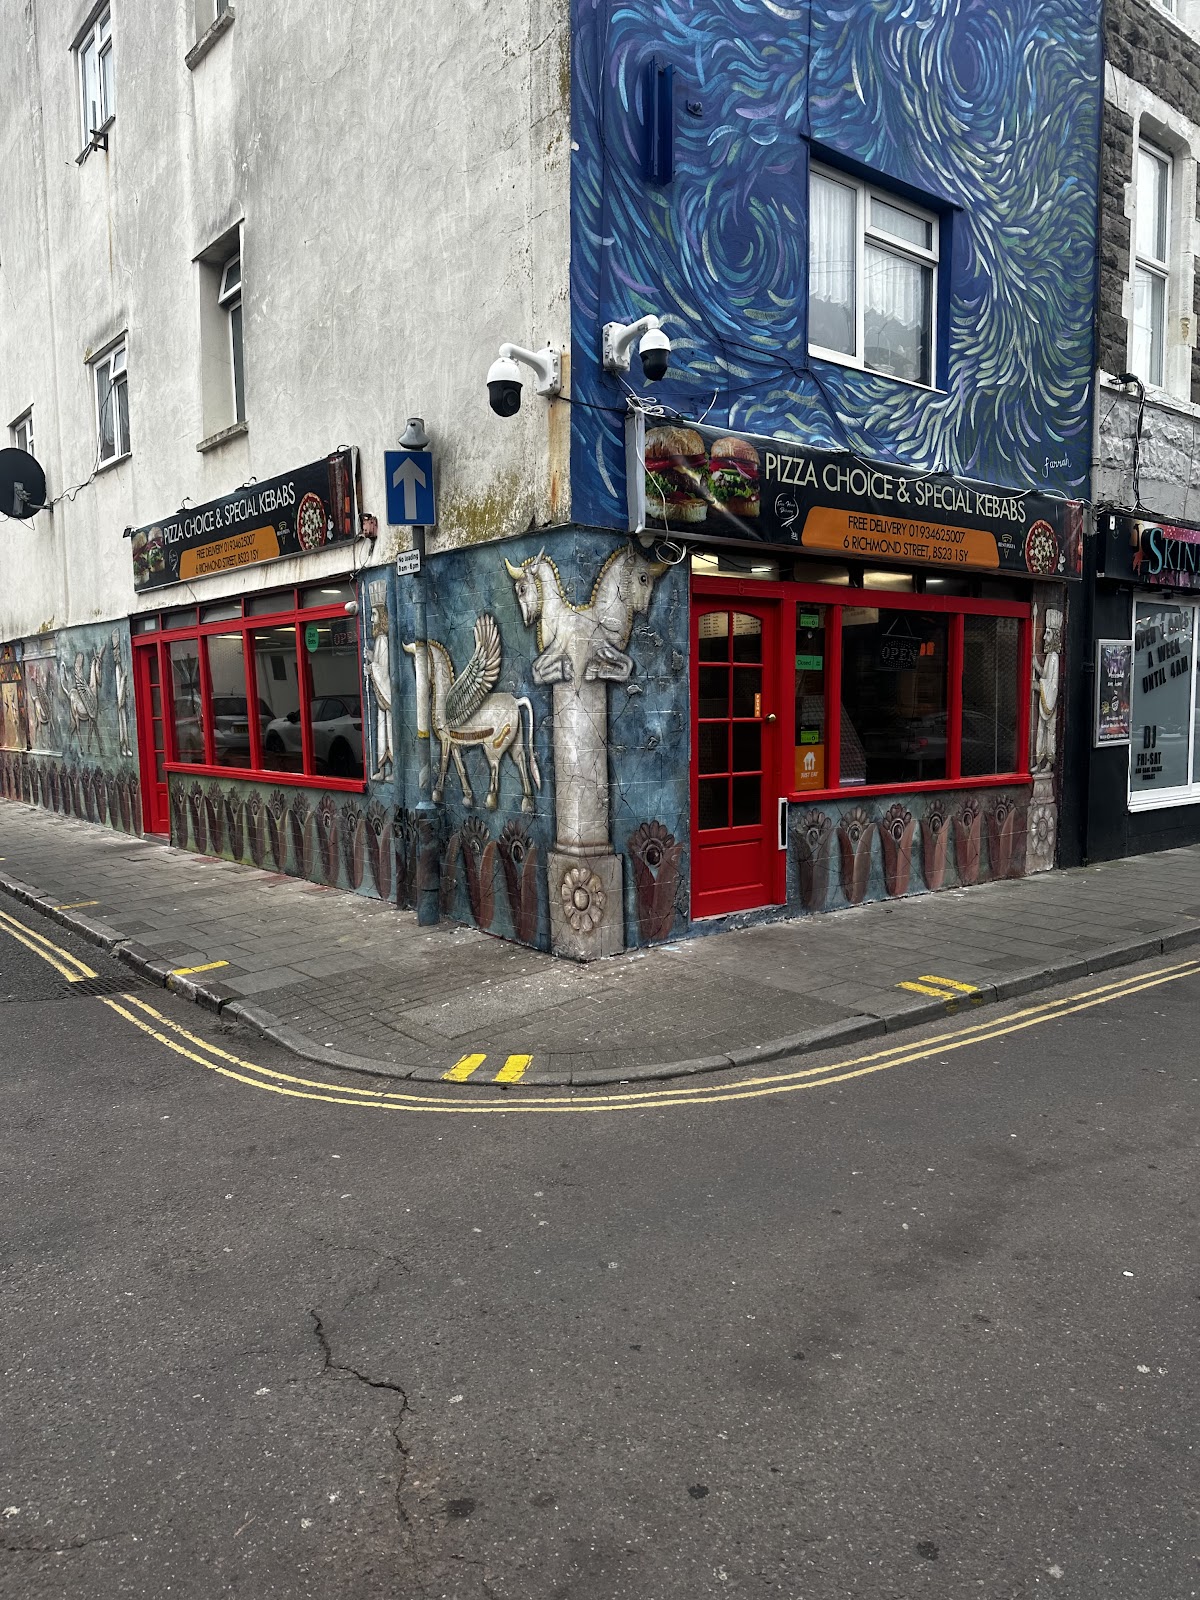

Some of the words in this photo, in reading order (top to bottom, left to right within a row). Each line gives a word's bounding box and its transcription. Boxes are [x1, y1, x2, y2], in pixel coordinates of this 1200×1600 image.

[765, 452, 819, 488] PIZZA
[822, 463, 893, 500] CHOICE
[897, 477, 911, 503] &
[915, 481, 973, 514] SPECIAL
[976, 494, 1026, 523] KEBABS
[164, 524, 185, 545] PIZZA
[184, 511, 215, 539] CHOICE
[216, 508, 223, 528] &
[224, 496, 258, 525] SPECIAL
[259, 482, 296, 514] KEBABS
[848, 515, 868, 531] FREE
[869, 519, 907, 536] DELIVERY
[908, 524, 965, 544] 01934625007
[196, 549, 205, 560] FREE
[205, 543, 224, 557] DELIVERY
[843, 535, 850, 548] 6
[852, 536, 901, 554] RICHMOND
[903, 542, 931, 560] STREET,
[932, 546, 952, 561] BS23
[955, 548, 969, 562] 1SY
[199, 558, 221, 573] RICHMOND
[237, 551, 249, 564] BS23
[1134, 626, 1157, 651] OPEN
[881, 646, 917, 662] OPEN
[1147, 651, 1154, 668] A
[1157, 638, 1181, 663] WEEK
[1142, 667, 1167, 694] UNTIL
[1170, 655, 1189, 678] 4AM
[1143, 725, 1157, 749] DJ
[1136, 752, 1162, 766] FRI-SAT
